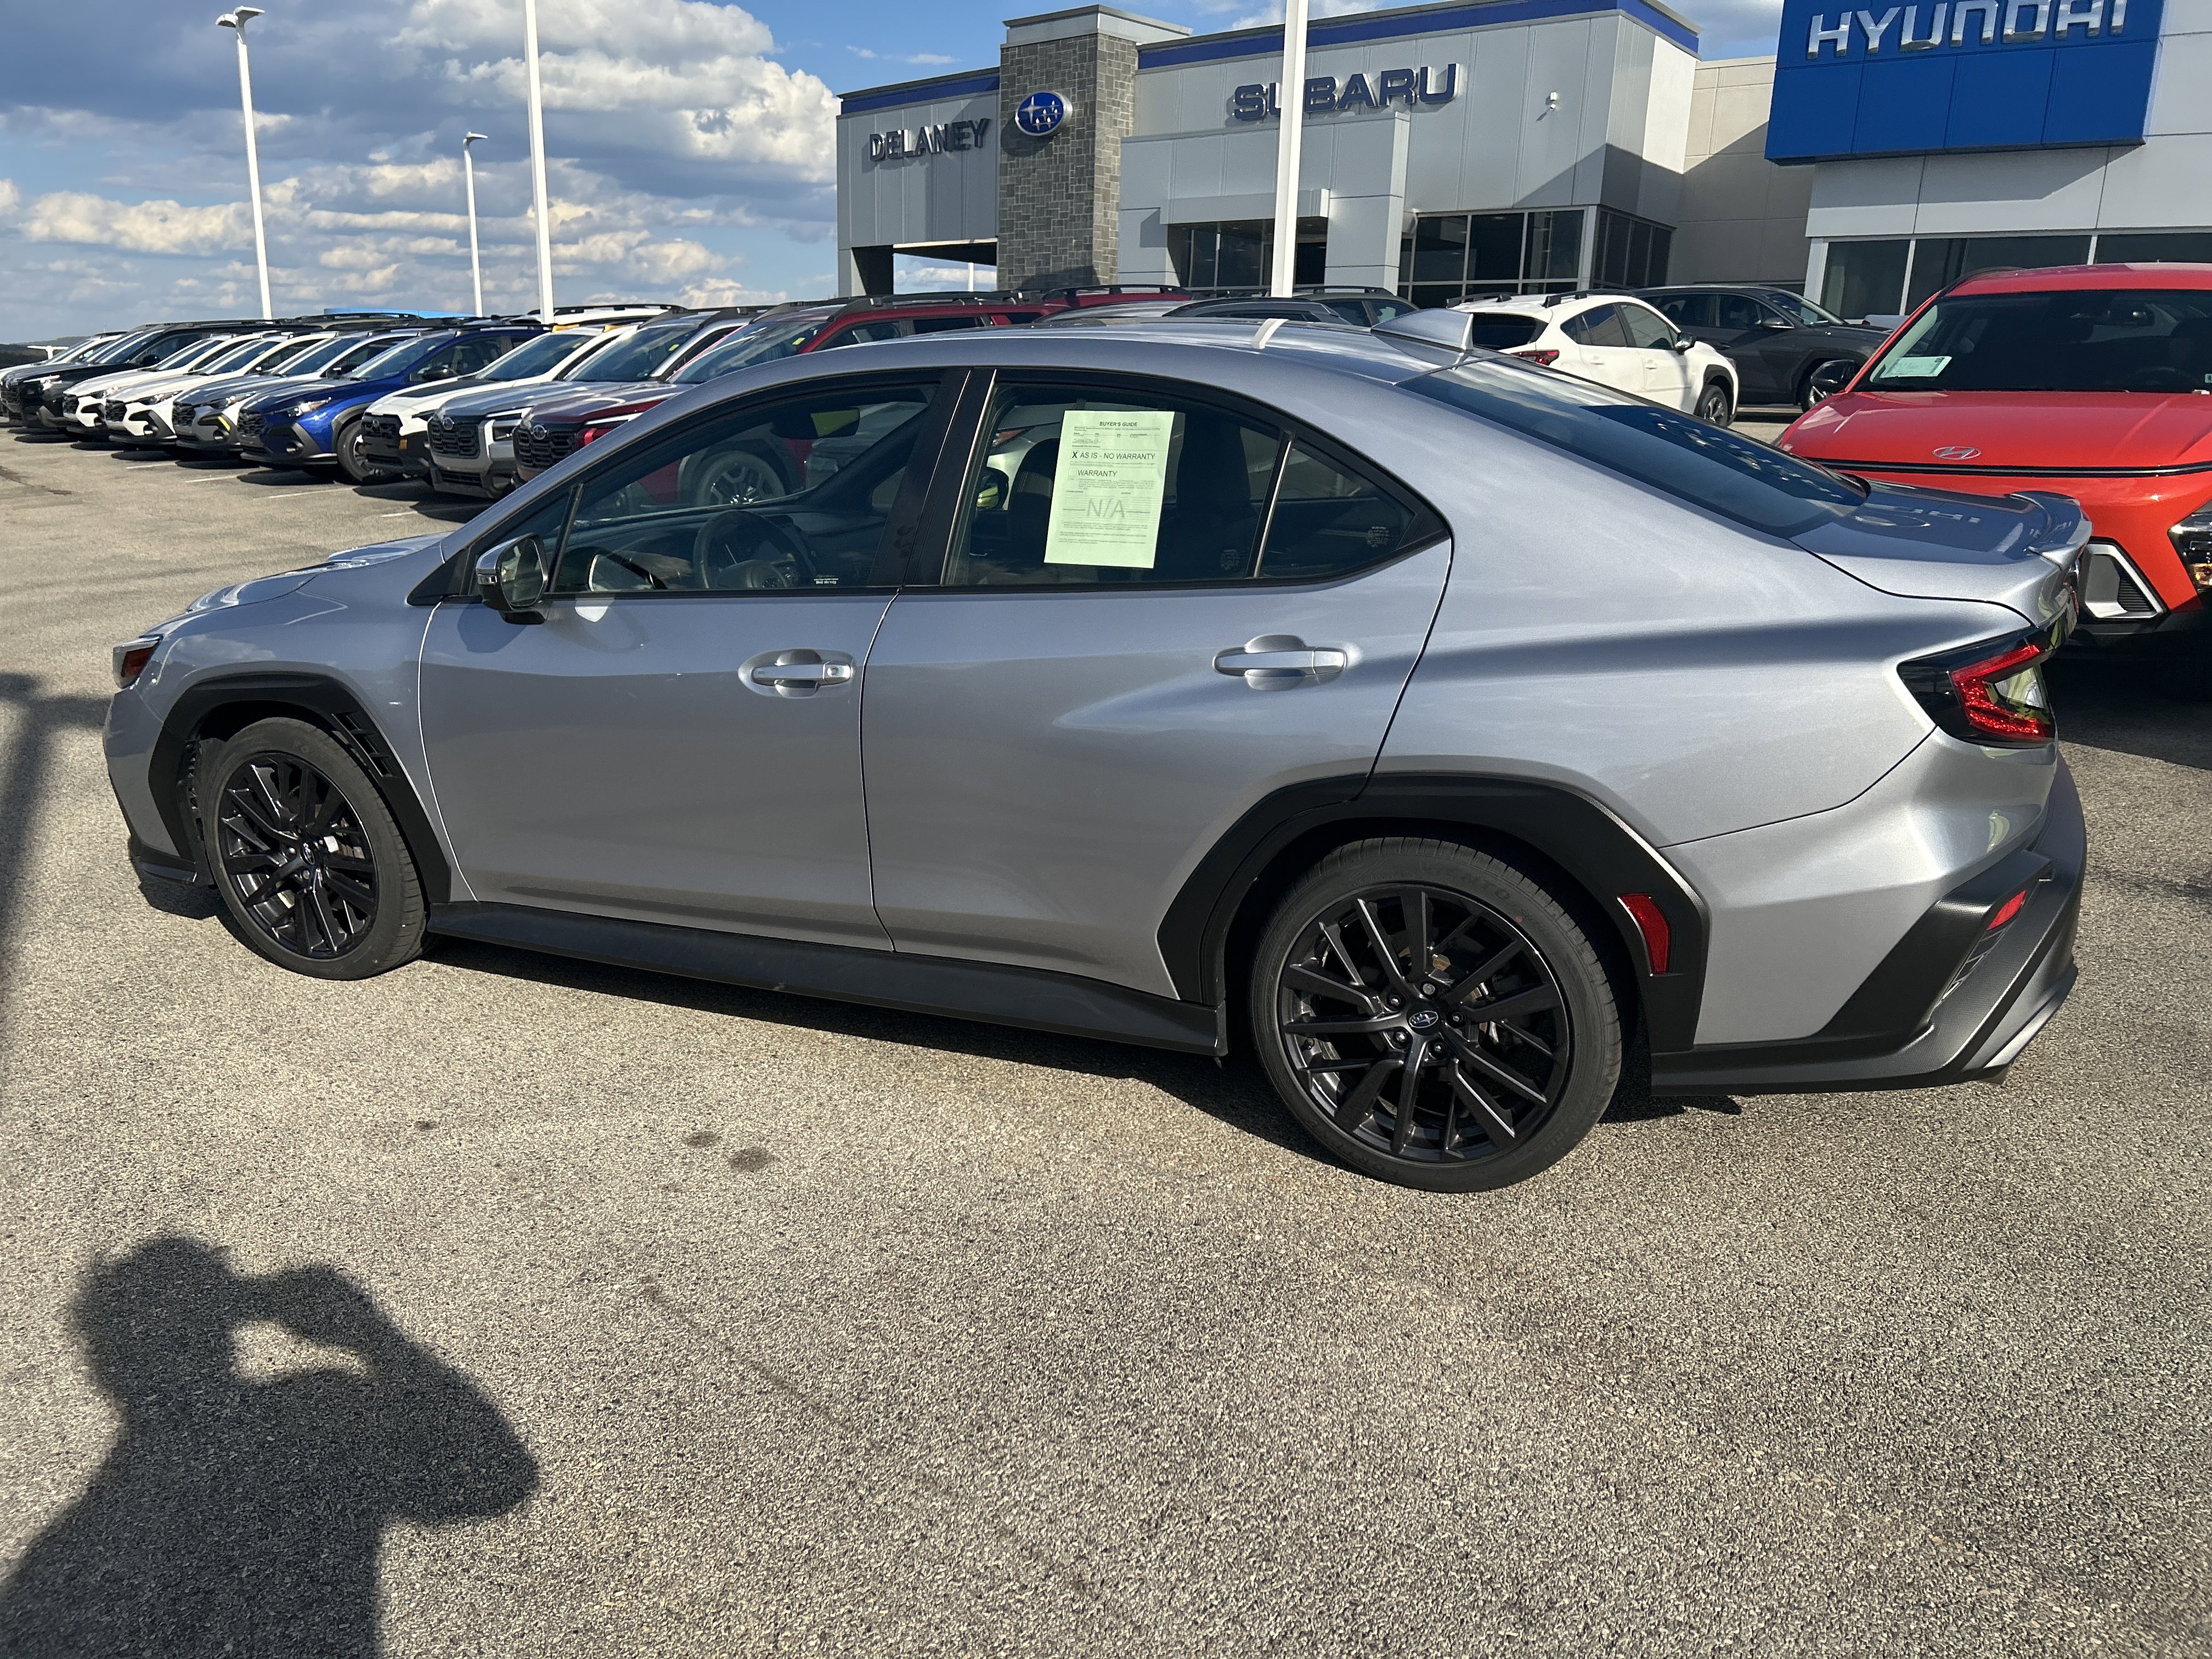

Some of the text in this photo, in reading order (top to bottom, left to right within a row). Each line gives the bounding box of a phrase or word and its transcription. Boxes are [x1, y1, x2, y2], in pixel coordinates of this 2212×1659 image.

[1807, 0, 2127, 60] HYUNDAI
[870, 118, 991, 161] DELANEY
[1087, 498, 1125, 518] N/A
